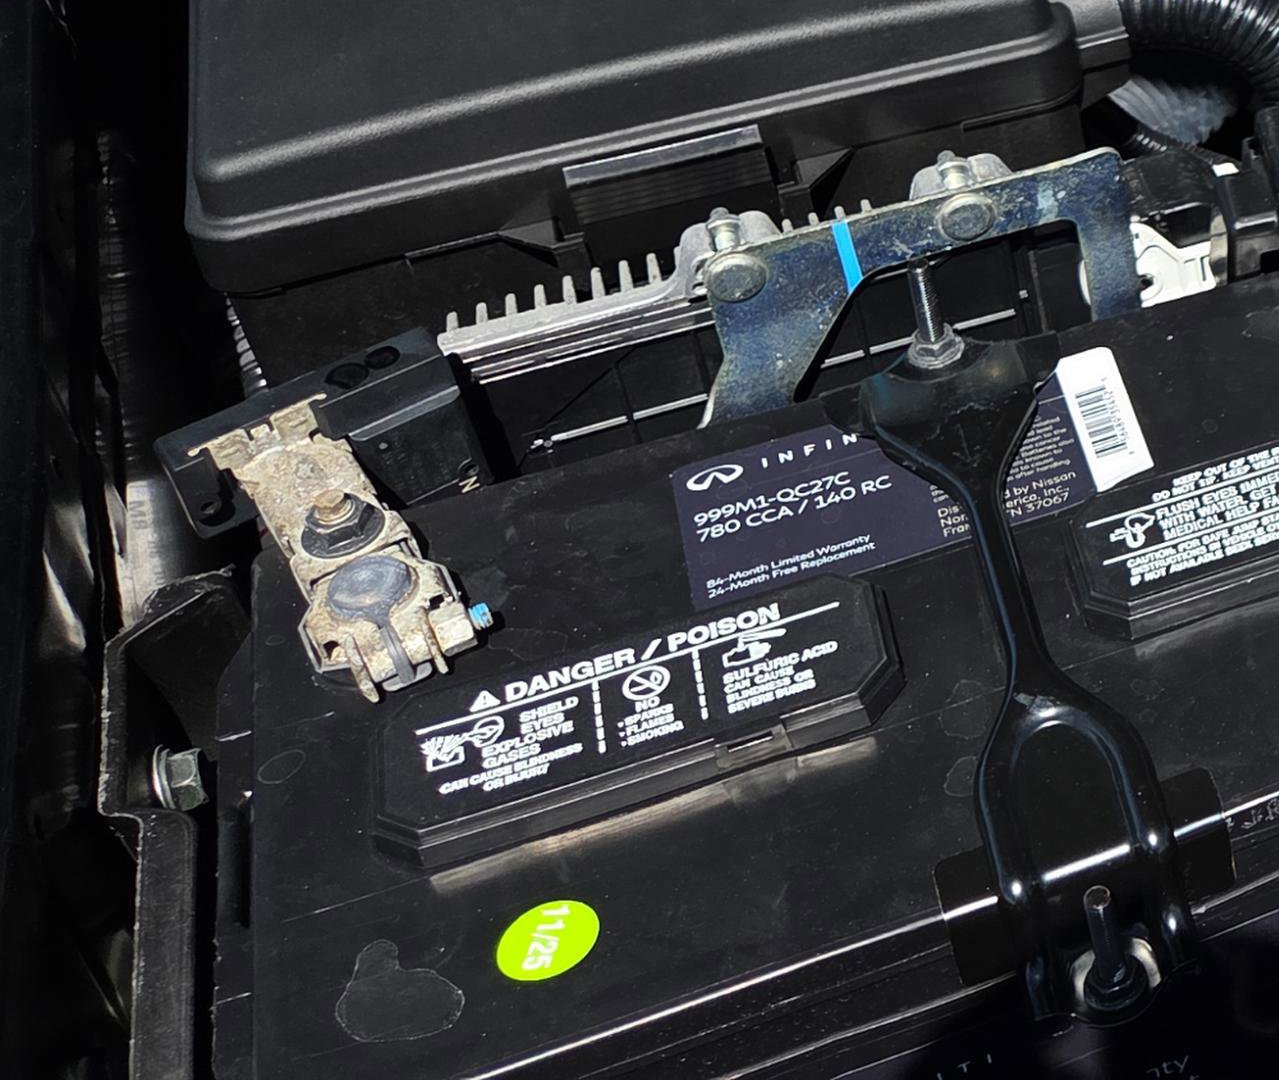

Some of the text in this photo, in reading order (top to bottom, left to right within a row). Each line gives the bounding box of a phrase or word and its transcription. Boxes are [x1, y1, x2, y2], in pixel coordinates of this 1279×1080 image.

[761, 433, 857, 467] INFIN
[694, 471, 850, 525] 999M1-QC27C
[1012, 485, 1029, 495] by
[1031, 471, 1076, 489] Nissan
[696, 518, 740, 541] 780
[745, 505, 793, 526] CCA
[814, 486, 855, 508] 140
[860, 475, 891, 494] RC
[1025, 492, 1068, 512] 37067
[1155, 497, 1200, 519] FLUSH
[1201, 485, 1237, 504] EYES
[1158, 510, 1195, 529] WITH
[1249, 483, 1276, 500] GET
[1163, 514, 1223, 540] MEDICAL
[1224, 501, 1259, 520] HELP
[706, 534, 871, 588] 84-Month Limited Warranty
[708, 542, 875, 598] 24-Month Free Replacement
[505, 648, 634, 701] DANGER
[667, 603, 779, 651] POISON
[722, 640, 837, 684] SULFURIC ACID
[723, 665, 794, 694] CAN CAUSE
[726, 668, 813, 703] BLINDNESS OR
[519, 696, 578, 722] SHIELD
[634, 695, 660, 712] NO
[481, 720, 573, 757] EXPLOSIVE
[520, 712, 564, 734] EYES
[482, 743, 540, 768] GASES
[522, 904, 571, 971] 11/25
